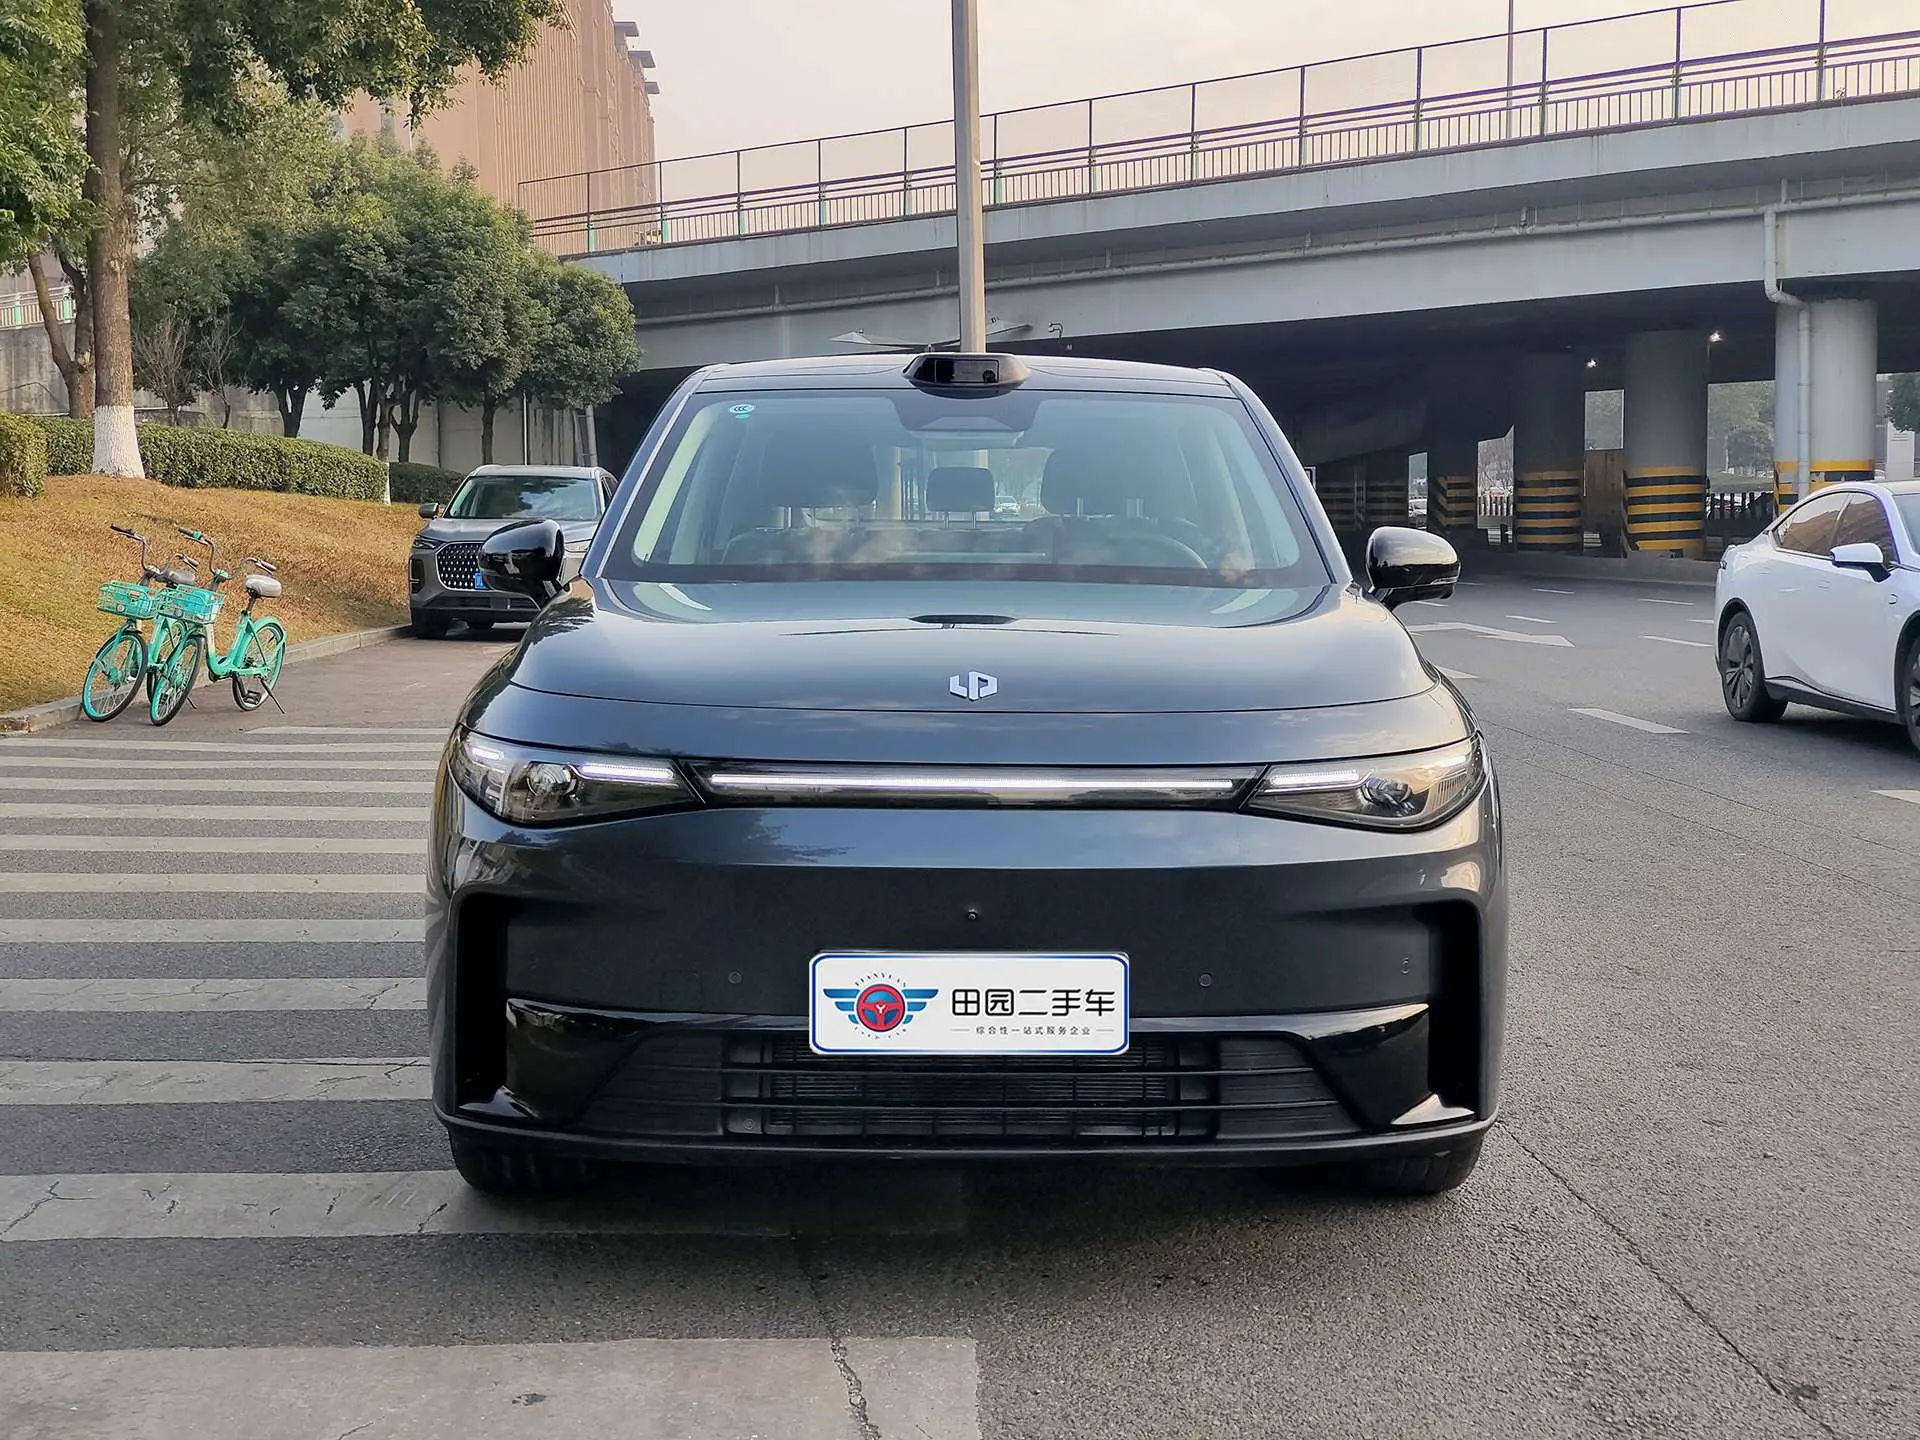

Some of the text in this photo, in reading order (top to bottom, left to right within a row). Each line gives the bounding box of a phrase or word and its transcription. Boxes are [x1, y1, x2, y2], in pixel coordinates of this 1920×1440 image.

[952, 988, 1115, 1017] 田园二手车
[976, 1026, 1090, 1035] 综合性一站式服务企业
